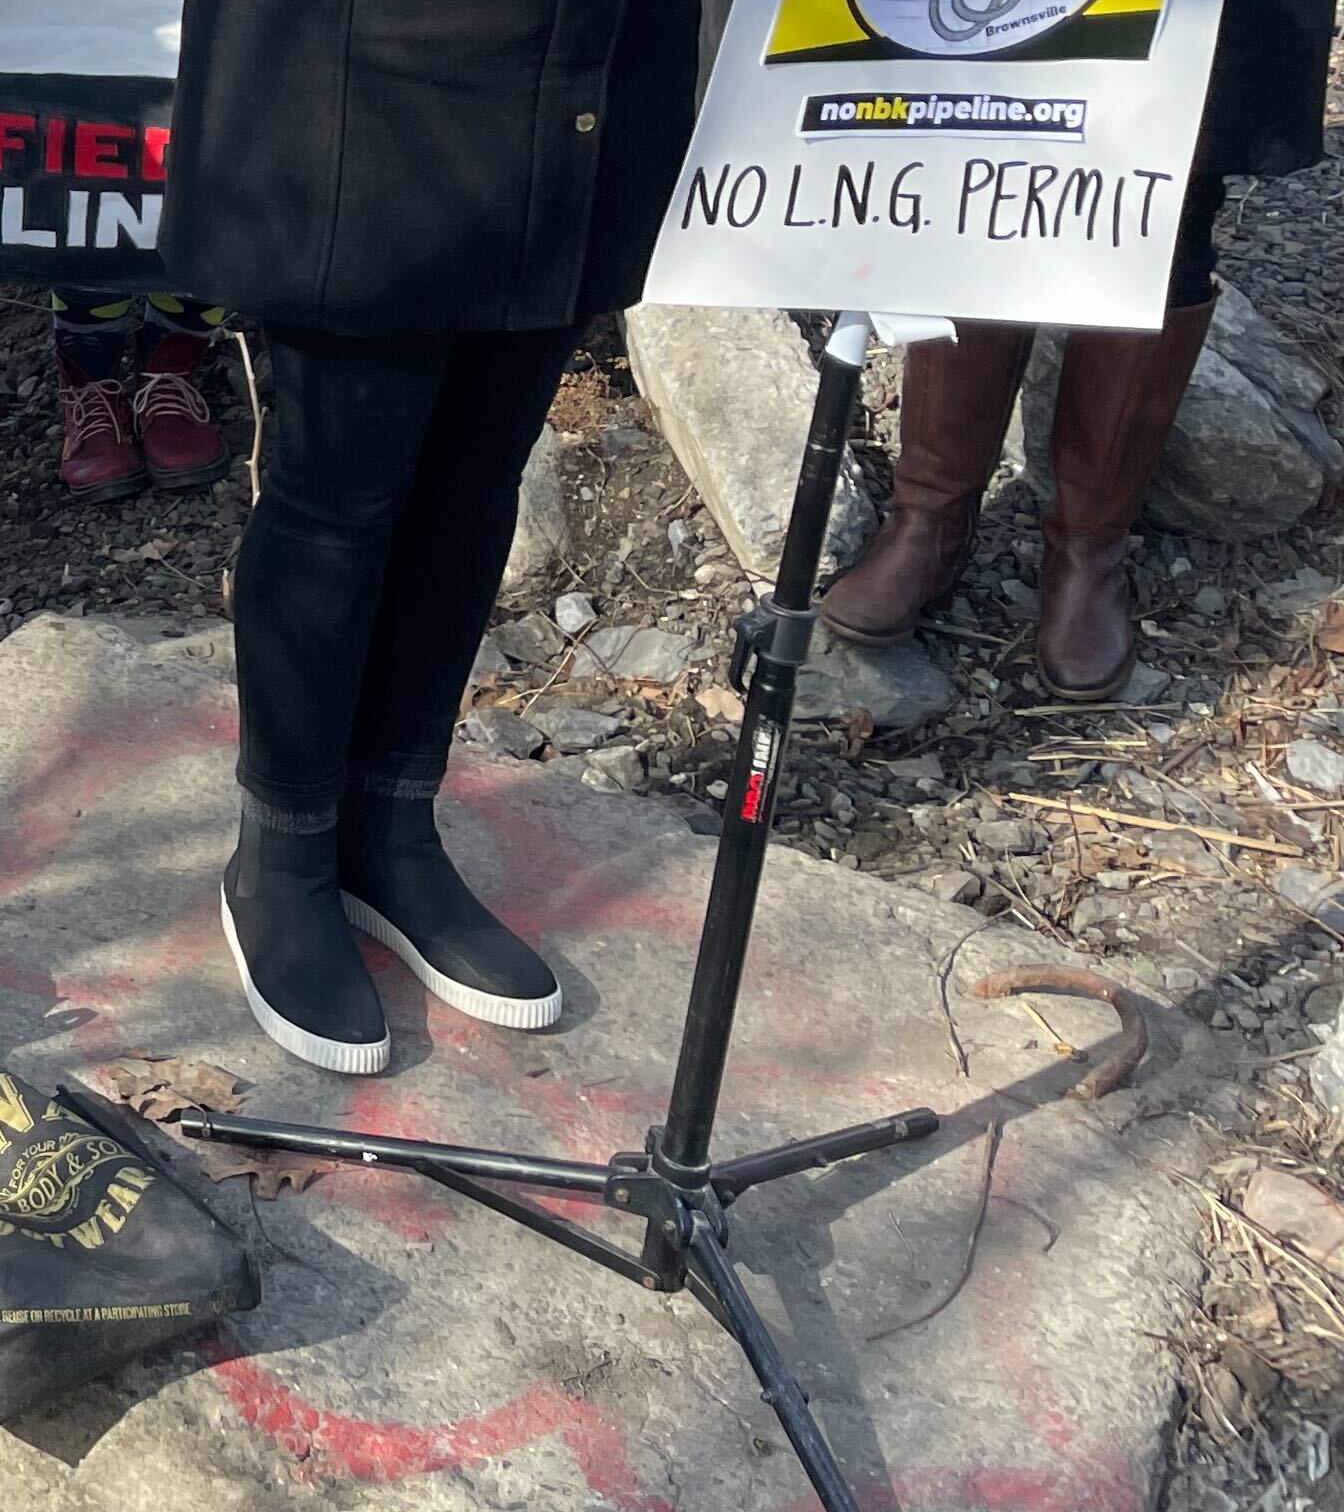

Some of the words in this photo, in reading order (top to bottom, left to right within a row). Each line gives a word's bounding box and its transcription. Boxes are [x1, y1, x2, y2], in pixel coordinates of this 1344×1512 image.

[985, 4, 1067, 37] Brownsville
[820, 94, 1086, 132] nonbkpipeline.org
[681, 162, 767, 231] NO
[957, 158, 1173, 248] PERMIT
[9, 1158, 26, 1189] FOR
[22, 1140, 56, 1159] YOUR
[17, 1163, 64, 1213] BODY
[30, 1309, 43, 1323] OR
[44, 1308, 81, 1322] RECYCLE
[82, 1307, 93, 1321] AT
[94, 1306, 101, 1320] A
[101, 1304, 163, 1320] PARTICIPATING
